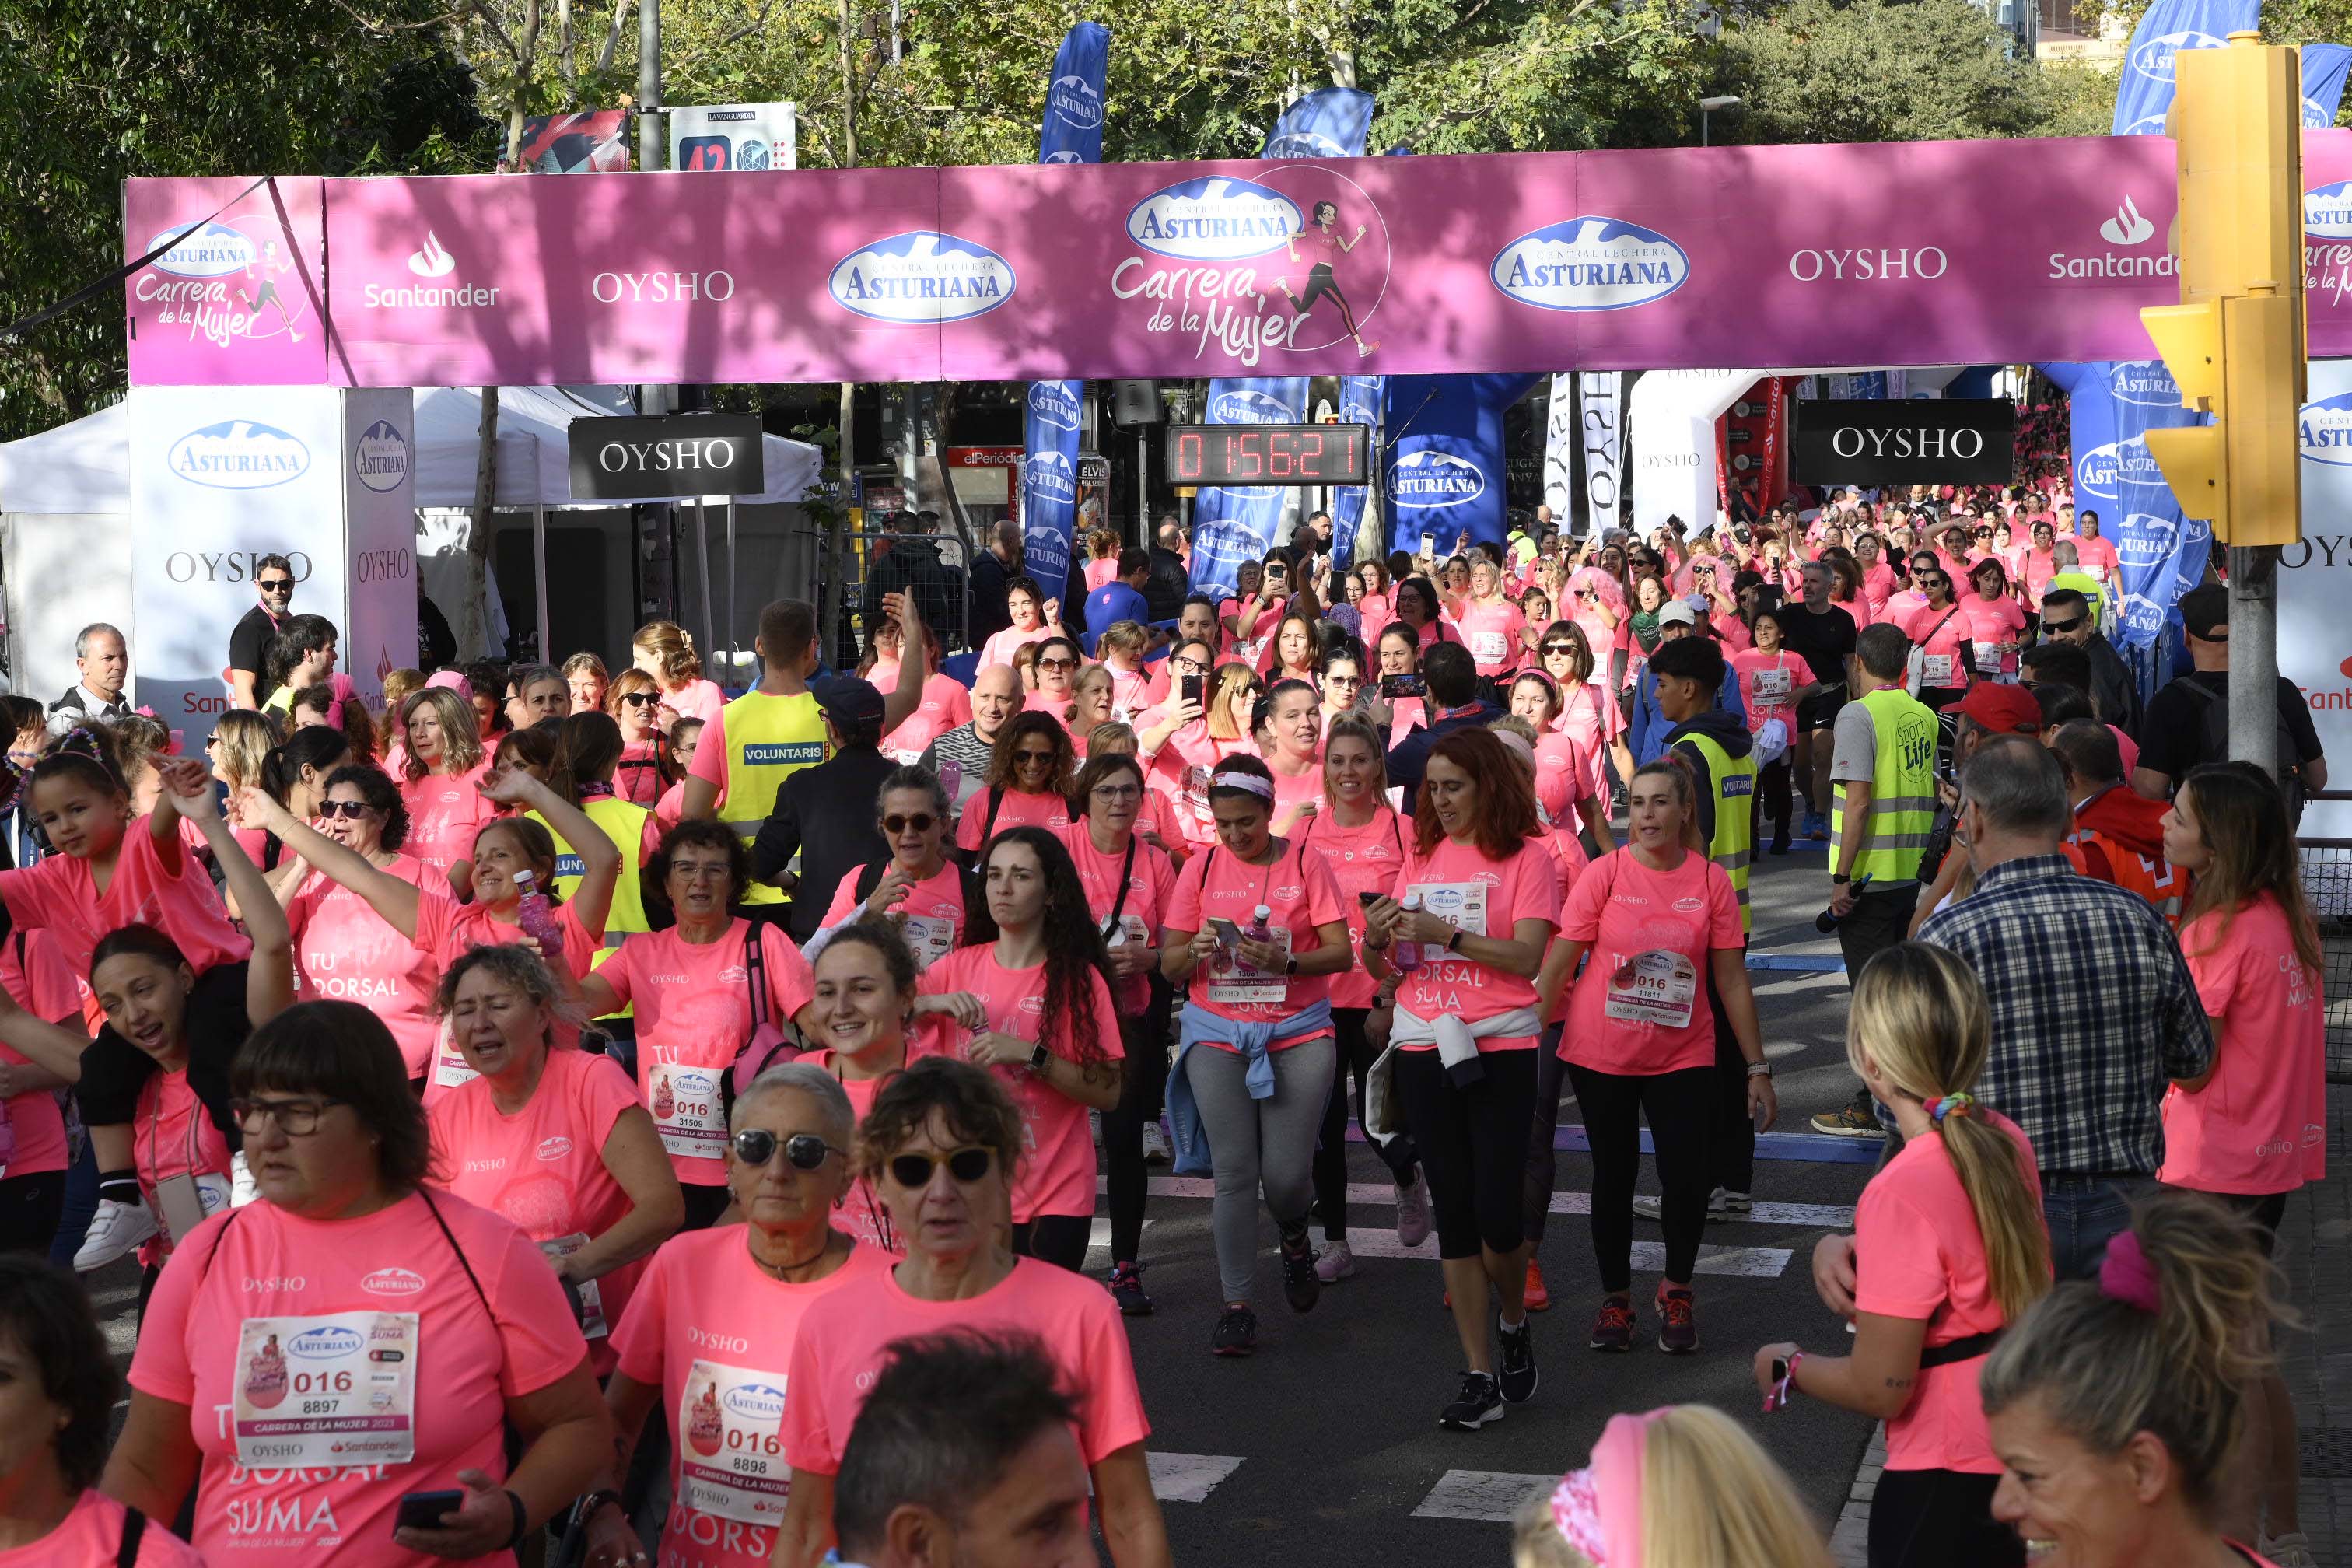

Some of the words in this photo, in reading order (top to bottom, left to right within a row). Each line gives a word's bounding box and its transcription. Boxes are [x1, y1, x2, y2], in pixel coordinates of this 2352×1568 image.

[718, 111, 754, 121] VANGUARDIA
[1139, 208, 1294, 240] ASTURIANA
[154, 243, 247, 263] ASTURIANA
[1536, 249, 1598, 261] CENTRAL
[1604, 247, 1668, 259] LECHERA
[1506, 253, 1675, 289] ASTURIANA
[1789, 245, 1948, 282] OYSHO
[135, 273, 228, 303] Carrera
[592, 270, 735, 303] OYSHO
[843, 265, 1002, 300] ASTURIANA
[1111, 256, 1258, 300] Carrera
[2322, 267, 2336, 289] la
[363, 282, 500, 308] Santander
[158, 303, 176, 324] de
[178, 303, 191, 324] la
[189, 300, 261, 348] Mujer
[1146, 301, 1174, 332] de
[1180, 301, 1199, 332] la
[1195, 293, 1312, 367] Mujer
[1832, 427, 1983, 458] OYSHO
[180, 446, 300, 472] ASTURIANA
[360, 451, 405, 475] ASTURIANA
[600, 439, 735, 472] OYSHO
[1641, 453, 1701, 468] OYSHO
[1081, 467, 1105, 477] ELVIS
[1398, 470, 1432, 478] CENTRAL
[1434, 468, 1474, 478] LECHERA
[1031, 471, 1074, 498] STURIAN
[1388, 474, 1477, 495] ASTURIANA
[1195, 529, 1262, 558] ASTURIANA
[357, 548, 408, 583] OYSHO
[1752, 716, 1764, 725] SU
[1898, 718, 1926, 747] Sport
[745, 747, 821, 760] VOLUNTARIS
[1904, 736, 1930, 770] Life
[1192, 783, 1208, 795] 016
[1213, 890, 1247, 900] OYSHO
[1430, 896, 1461, 905] ASTURIANA
[310, 952, 336, 971] TU
[1639, 959, 1671, 970] ASTURIANA
[312, 978, 399, 996] DORSAL
[650, 974, 689, 985] OYSHO
[1637, 975, 1666, 989] 016
[1638, 989, 1661, 999] 11811
[1612, 1006, 1638, 1015] OYSHO
[1657, 1013, 1684, 1022] Santander
[652, 1045, 678, 1065] TU
[445, 1072, 473, 1080] OYSHO
[677, 1080, 712, 1091] ASTURIANA
[677, 1101, 708, 1116] 016
[679, 1118, 703, 1128] 31509
[242, 1276, 306, 1293] OYSHO
[366, 1277, 422, 1290] ASTURIANA
[371, 1330, 404, 1340] SUMA
[688, 1325, 748, 1354] OYSHO
[292, 1339, 358, 1353] ASTURIANA
[293, 1370, 352, 1394] 016
[303, 1399, 340, 1414] 8897
[729, 1394, 782, 1412] ASTURIAN
[214, 1403, 232, 1439] T
[254, 1421, 303, 1433] CARRERA
[303, 1422, 317, 1432] DE
[318, 1421, 332, 1430] LA
[334, 1419, 369, 1430] MUJER
[372, 1419, 396, 1428] 2023
[251, 1443, 303, 1458] OYSHO
[345, 1440, 399, 1454] Santander
[727, 1428, 781, 1455] 016
[733, 1457, 768, 1474] 8898
[695, 1467, 730, 1484] CARRERA
[731, 1476, 744, 1486] DE
[745, 1479, 758, 1489] LA
[691, 1486, 730, 1507] OYSHO
[226, 1495, 339, 1535] SUMA
[673, 1506, 775, 1559] DORS
